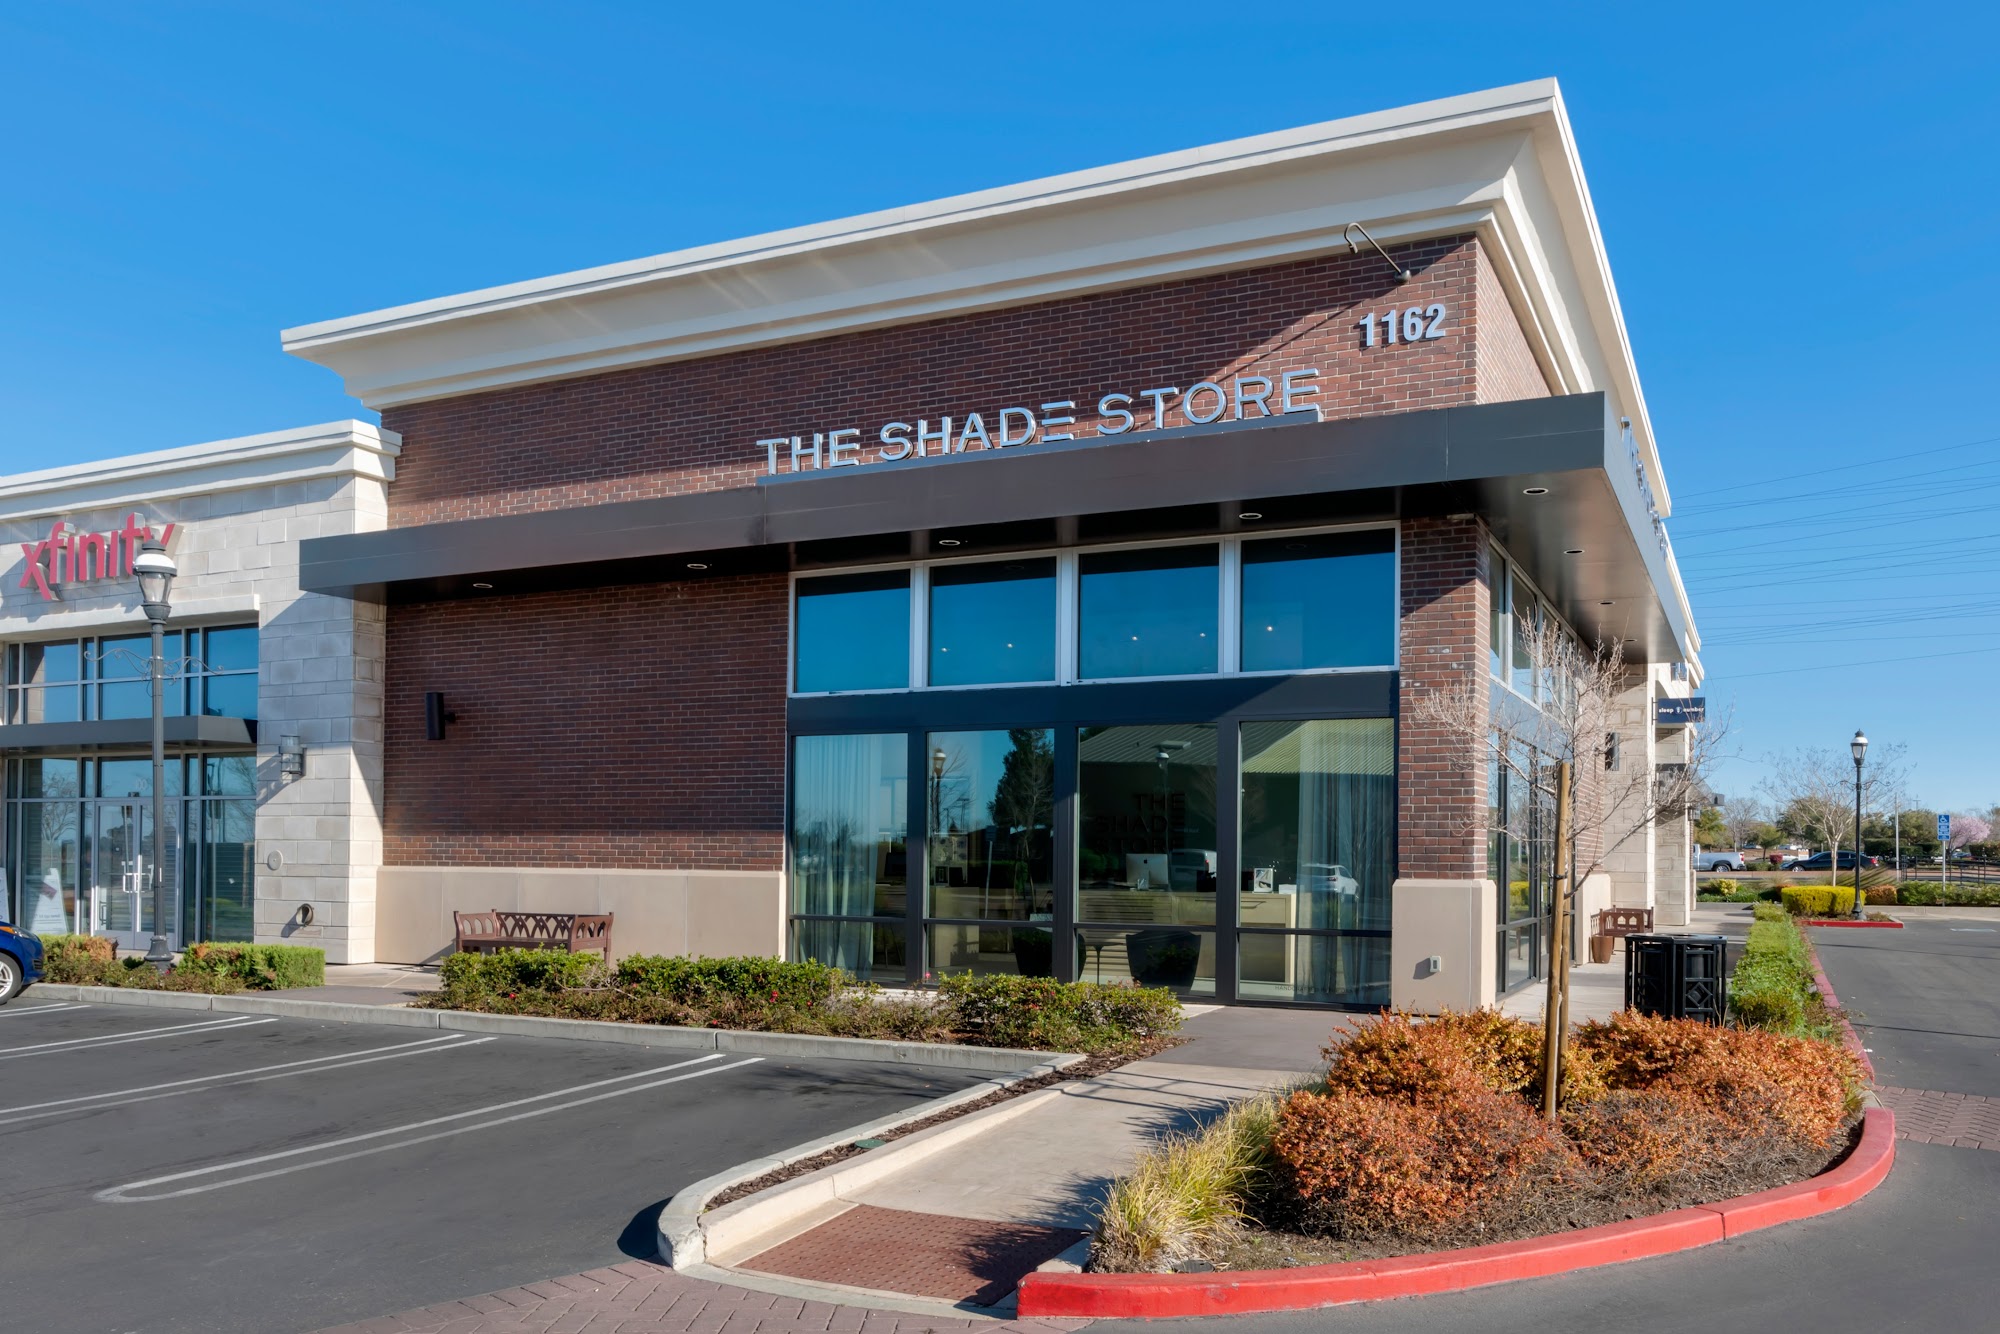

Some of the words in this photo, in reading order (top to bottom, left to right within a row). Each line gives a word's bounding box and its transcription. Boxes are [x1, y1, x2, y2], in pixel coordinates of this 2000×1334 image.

[1359, 303, 1446, 347] 1162
[756, 428, 861, 475] THE
[879, 400, 1075, 461] SHADE
[1096, 367, 1319, 435] STORE
[1132, 792, 1185, 809] THE
[1094, 815, 1185, 833] SHADE
